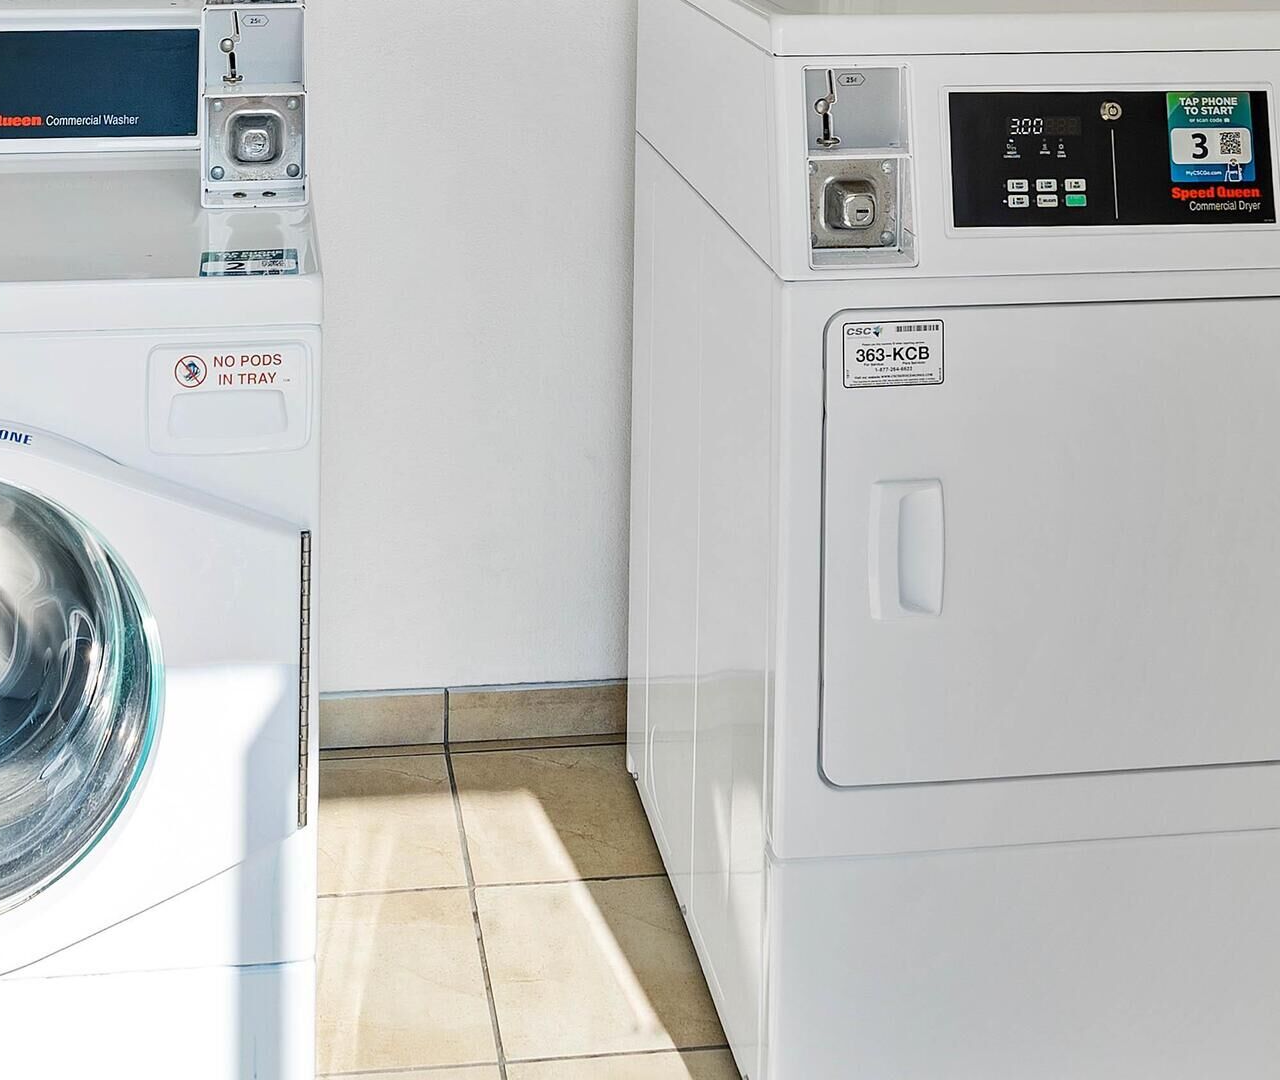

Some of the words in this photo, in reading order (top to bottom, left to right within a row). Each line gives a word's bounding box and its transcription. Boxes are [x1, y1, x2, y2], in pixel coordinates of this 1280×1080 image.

[1179, 98, 1199, 106] TAP
[1201, 97, 1238, 106] PHONE
[1184, 107, 1198, 115] TO
[1201, 106, 1234, 115] START
[45, 115, 101, 127] Commercial
[103, 114, 139, 126] Washer
[1010, 118, 1043, 134] 3.00
[1191, 133, 1209, 159] 3
[1171, 186, 1215, 200] Speed
[1216, 186, 1260, 197] Queen
[1189, 201, 1236, 211] Commercial
[1239, 201, 1261, 212] Dryer
[225, 262, 245, 270] 2
[847, 327, 872, 336] CSC
[214, 355, 235, 367] NO
[240, 354, 282, 366] PODS
[856, 346, 929, 362] 363-KCB
[218, 374, 233, 385] IN
[238, 372, 277, 384] TRAY
